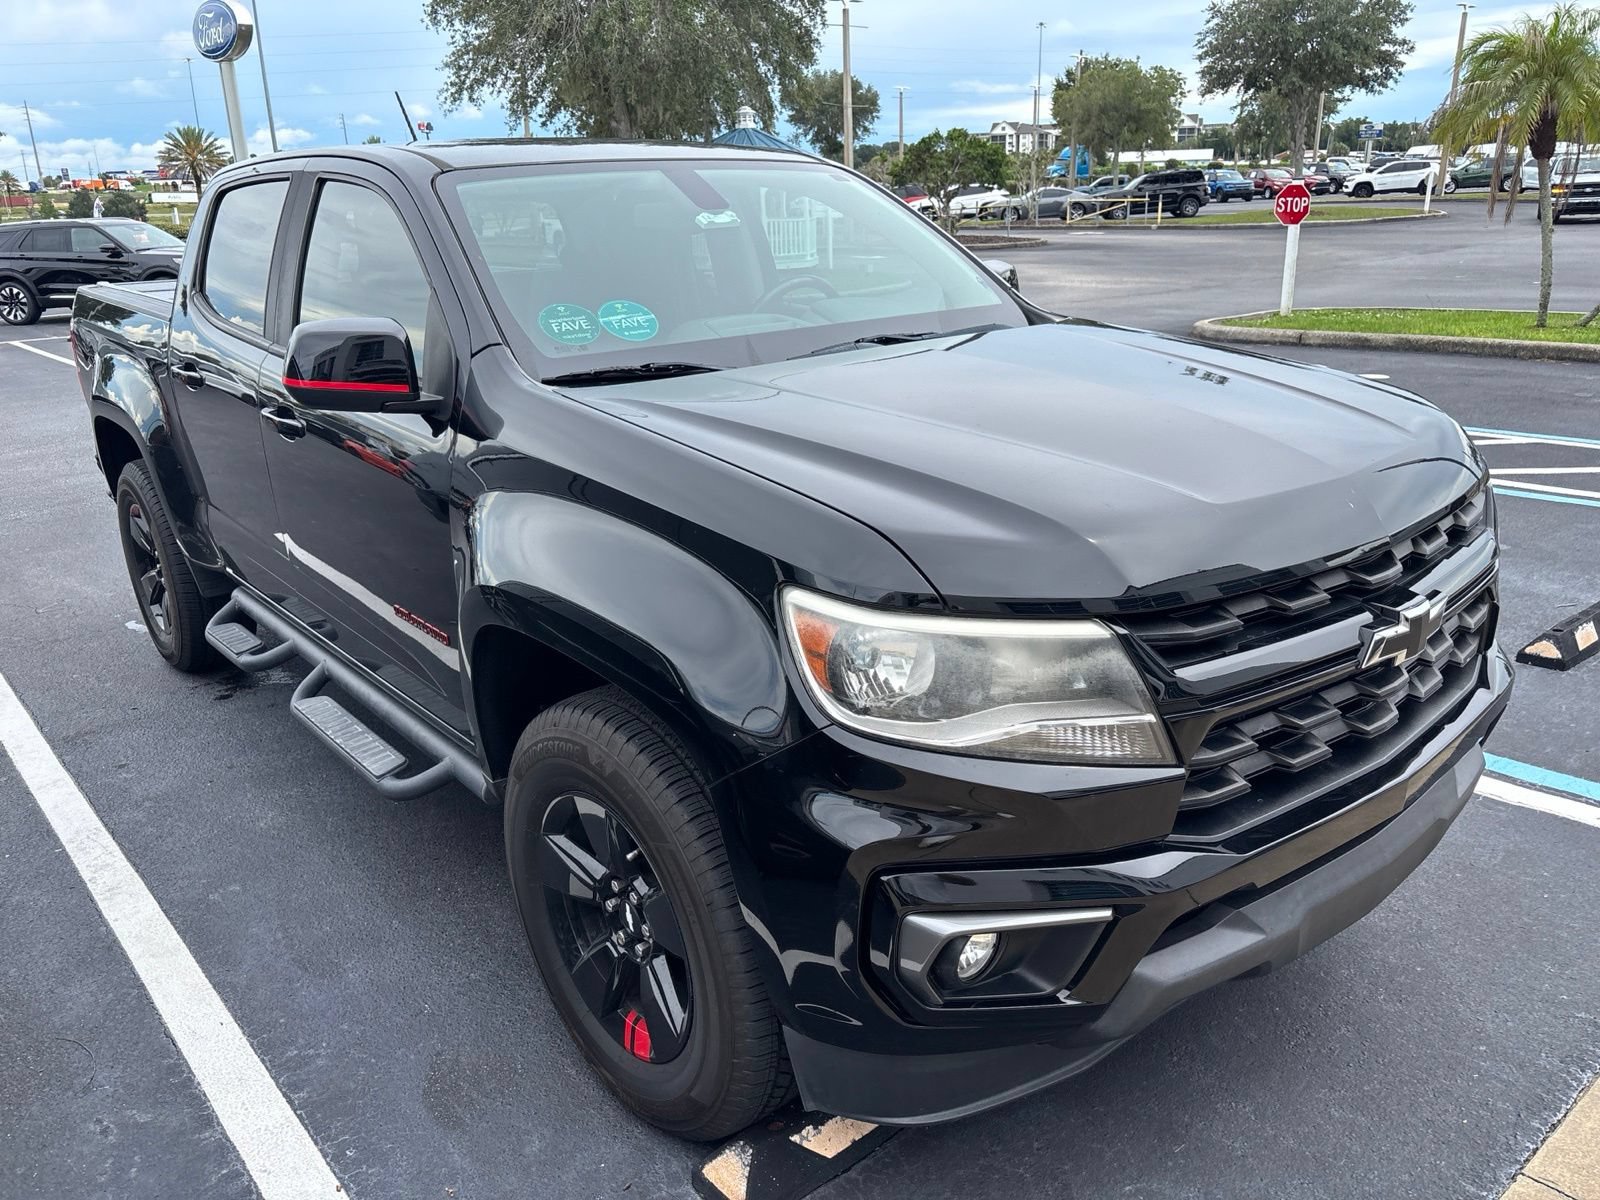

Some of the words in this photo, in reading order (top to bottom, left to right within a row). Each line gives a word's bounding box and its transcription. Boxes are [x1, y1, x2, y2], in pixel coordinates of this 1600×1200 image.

[199, 11, 224, 49] Ford
[1276, 197, 1309, 213] STOP
[551, 319, 592, 334] FAVE
[611, 316, 650, 329] FAVE
